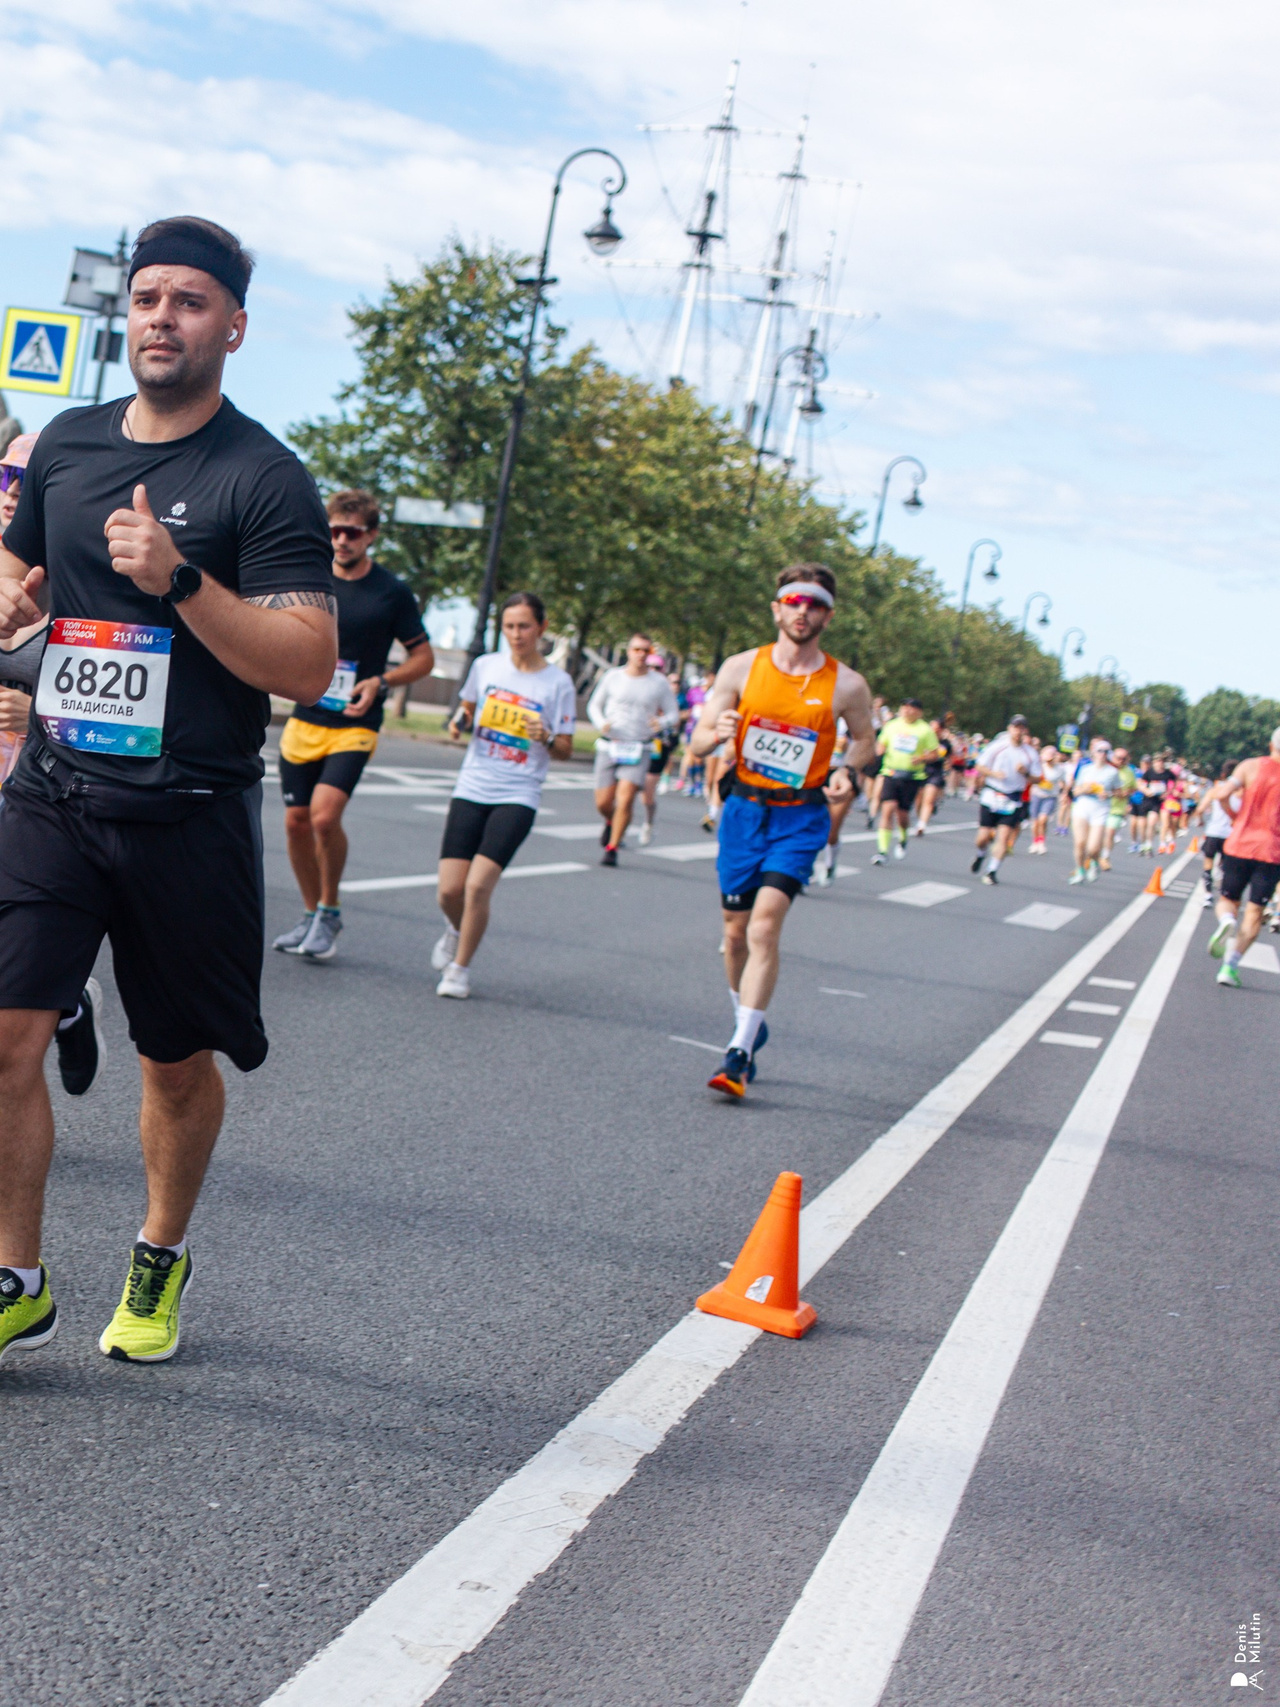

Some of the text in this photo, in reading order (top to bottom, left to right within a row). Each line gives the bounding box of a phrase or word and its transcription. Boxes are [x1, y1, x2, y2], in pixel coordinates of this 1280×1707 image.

[61, 629, 97, 639] МАРАФОН
[63, 621, 82, 629] ПОЛУ
[112, 631, 132, 643] 21,1
[55, 656, 148, 702] 6820
[61, 698, 134, 717] ВЛАДИСЛАВ
[47, 719, 61, 740] E
[754, 734, 804, 761] 6479
